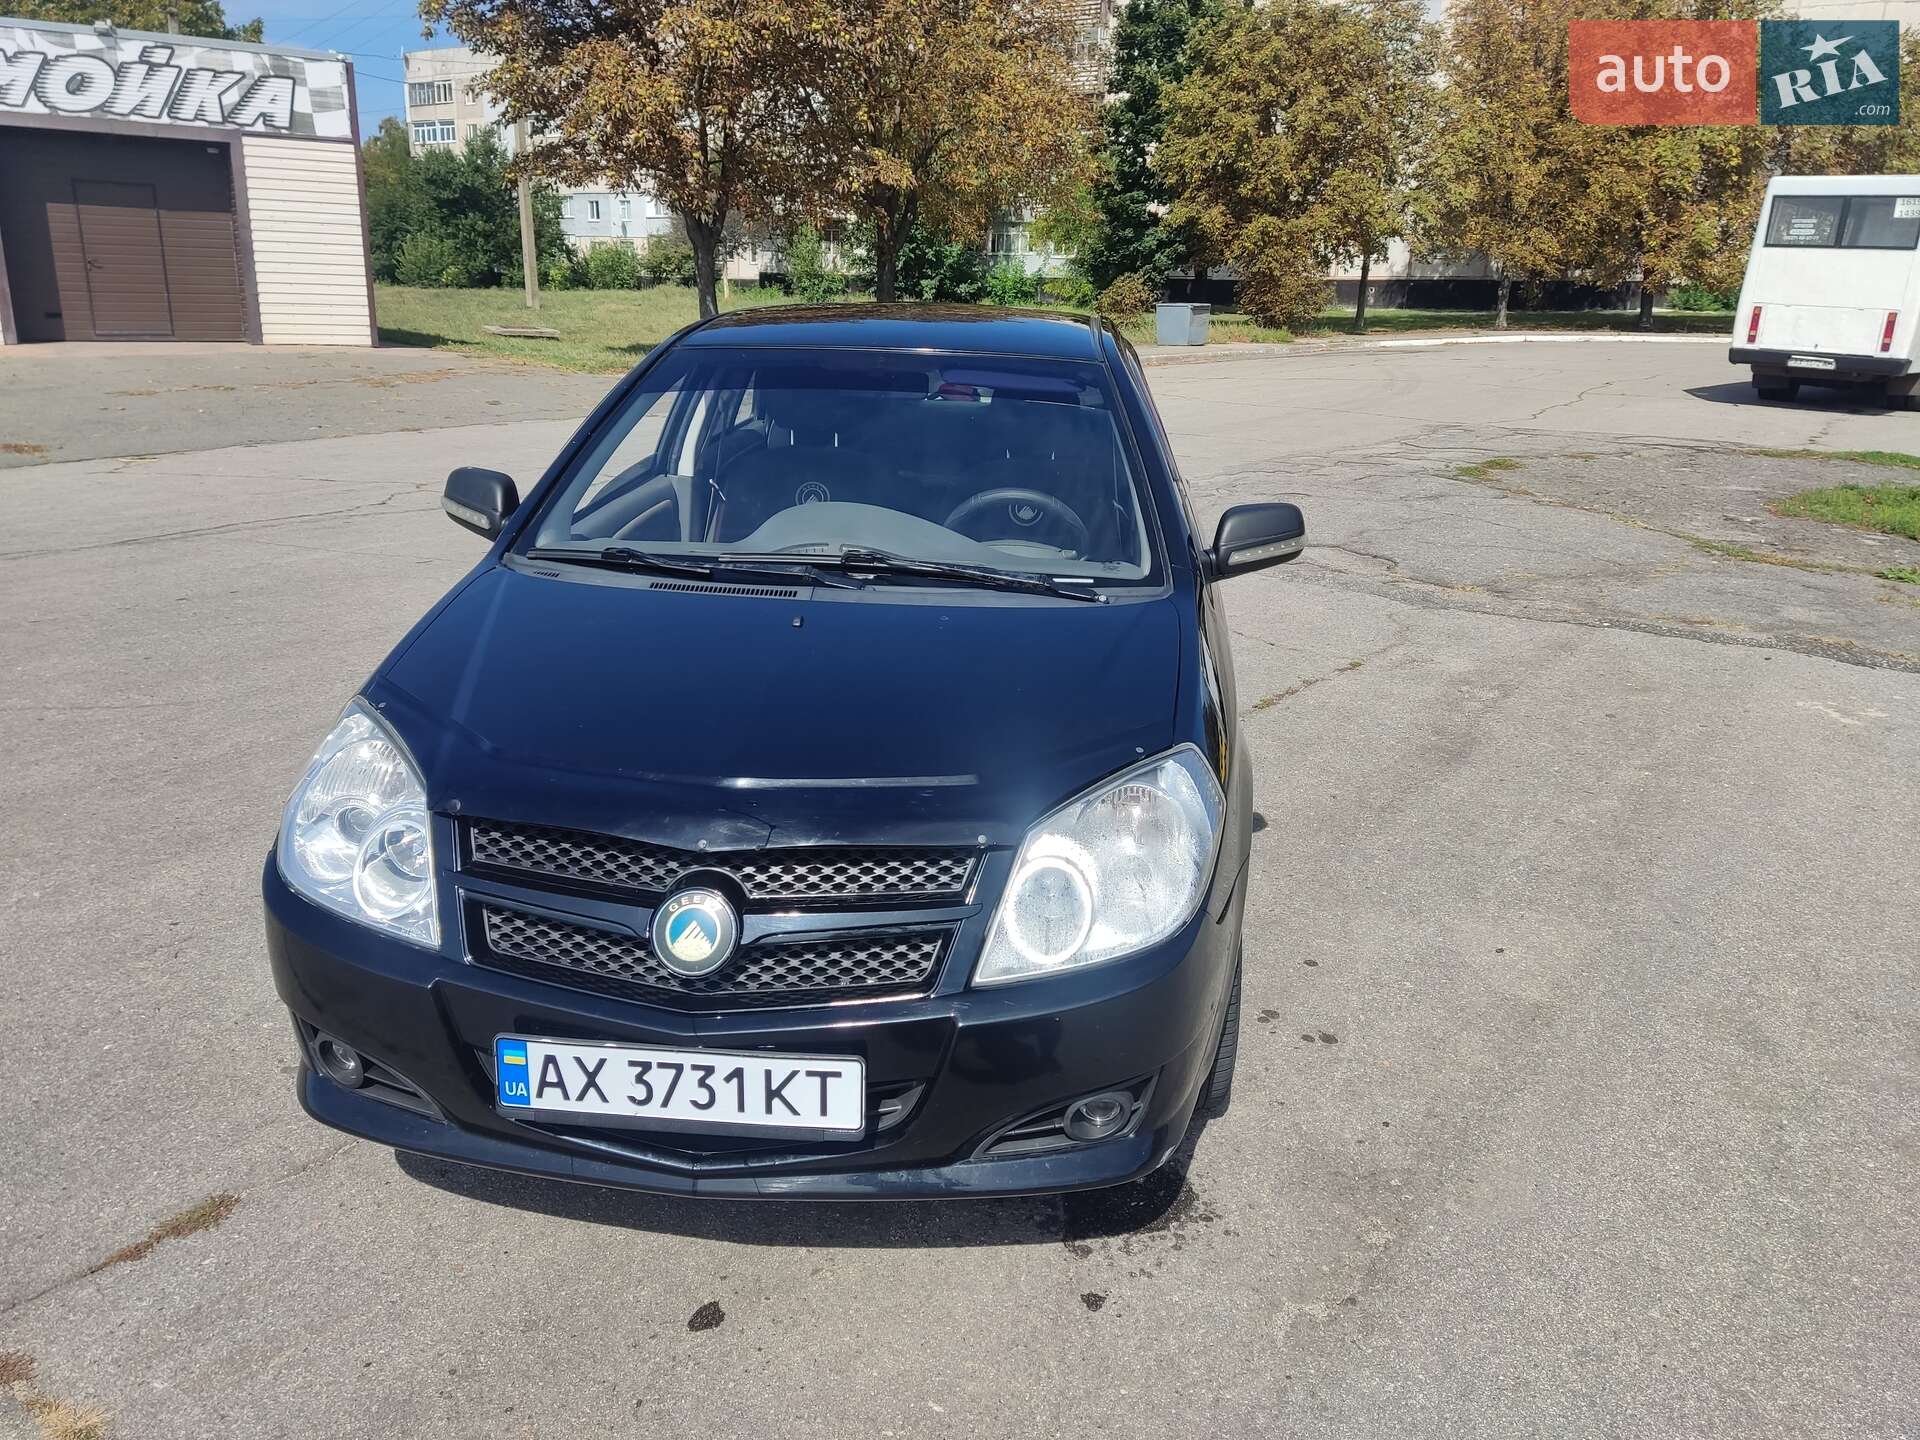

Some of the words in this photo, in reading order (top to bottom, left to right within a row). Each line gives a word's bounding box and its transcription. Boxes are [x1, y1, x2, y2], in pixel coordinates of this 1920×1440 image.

[505, 1081, 528, 1097] UA
[535, 1054, 609, 1103] AX
[626, 1060, 746, 1114] 3731
[764, 1068, 843, 1117] KT
